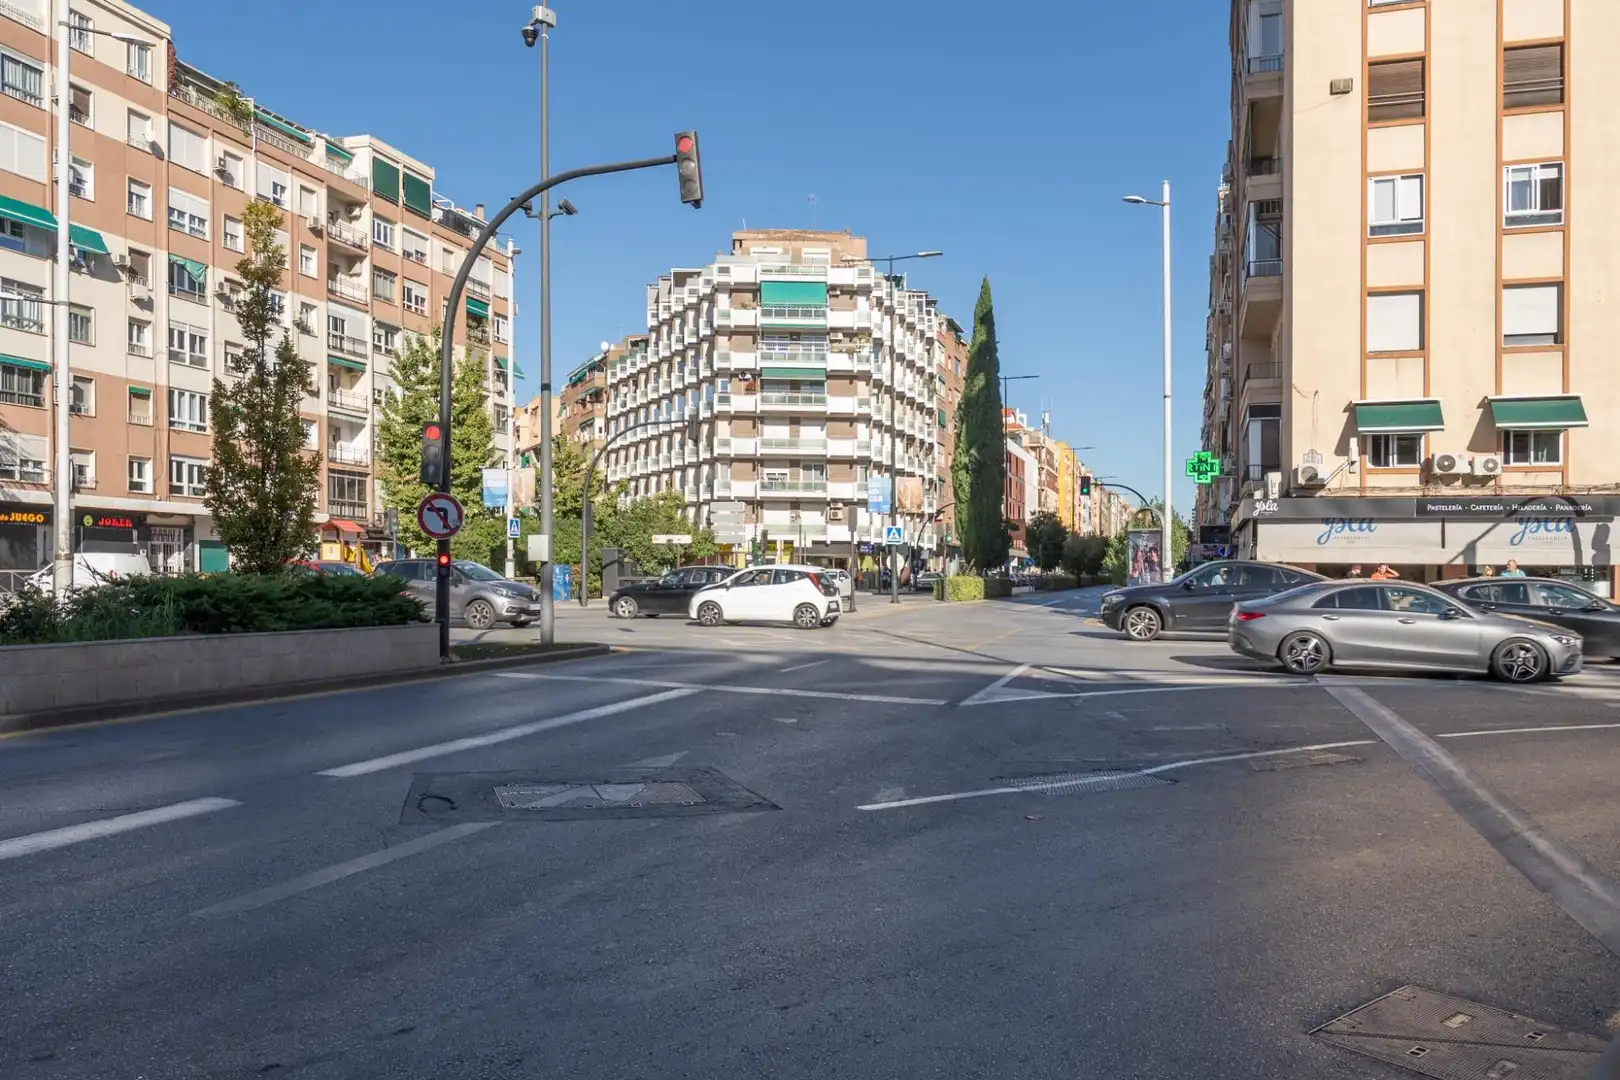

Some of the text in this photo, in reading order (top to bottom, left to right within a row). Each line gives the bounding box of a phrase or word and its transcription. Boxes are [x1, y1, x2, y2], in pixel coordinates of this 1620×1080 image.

[1427, 503, 1463, 511] PASTELERÍA
[1470, 503, 1504, 511] CAFETERÍA
[10, 512, 44, 523] JUEGO
